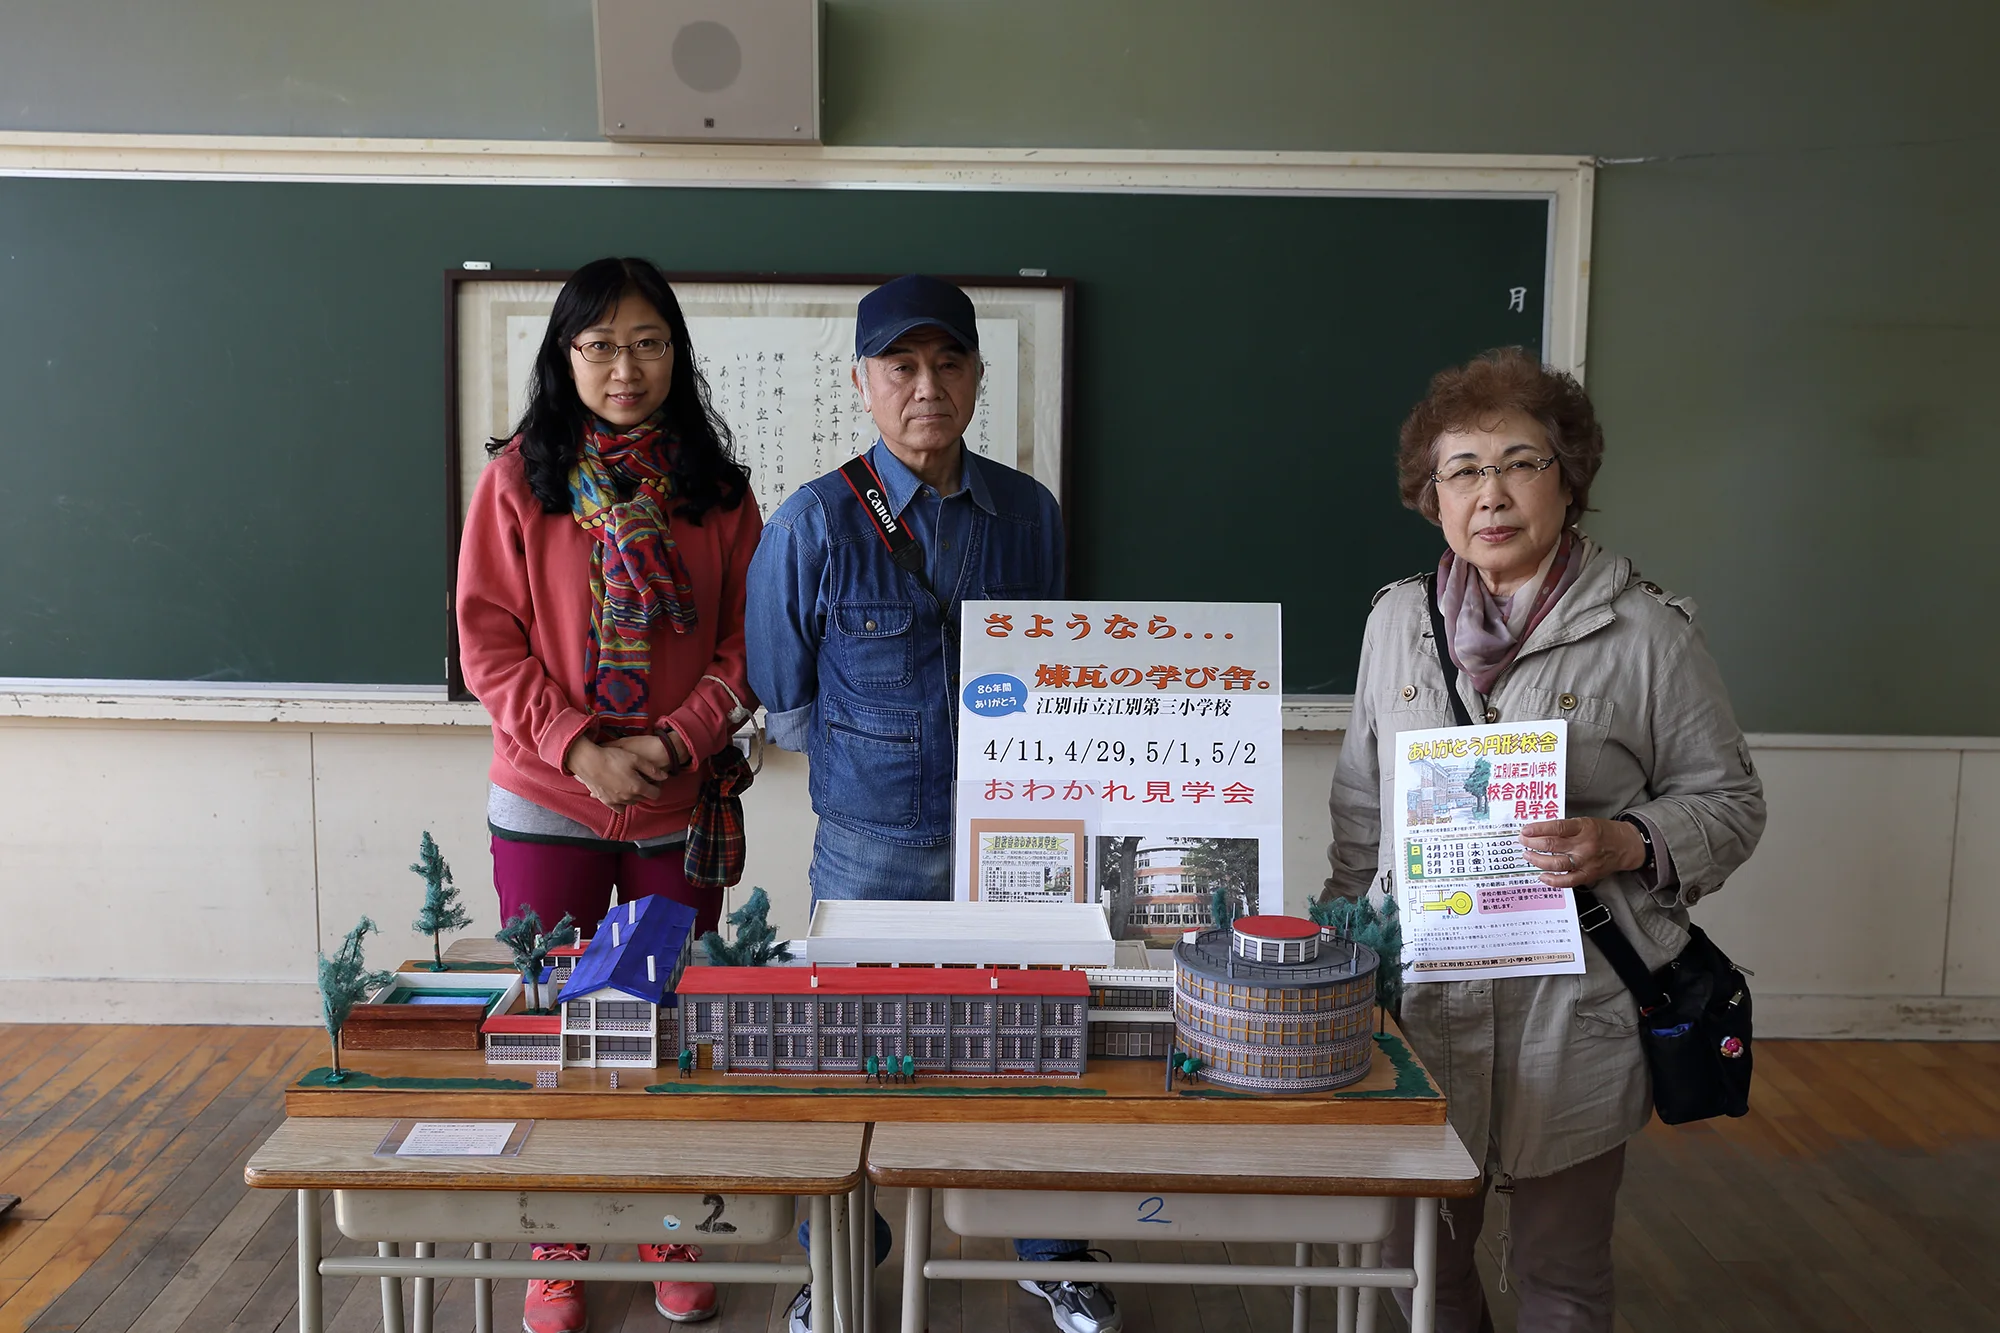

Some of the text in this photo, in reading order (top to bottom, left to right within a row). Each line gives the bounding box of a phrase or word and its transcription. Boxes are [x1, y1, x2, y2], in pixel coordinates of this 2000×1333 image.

[1508, 286, 1527, 313] 月
[866, 489, 897, 533] Canon
[977, 683, 1012, 694] 86年間
[1034, 663, 1270, 691] 煉瓦の学び舎。
[974, 696, 1017, 708] ありがとう
[1036, 696, 1232, 717] 江別市立江別第三小学校
[1408, 731, 1558, 761] ありがとう円形校舎
[1494, 761, 1557, 778] 江別第三小学校
[984, 778, 1255, 804] おわかれ見学会
[1487, 781, 1558, 801] 校舎お別れ
[1514, 801, 1559, 820] 見学会
[695, 1193, 737, 1234] 2
[1137, 1196, 1172, 1224] 2
